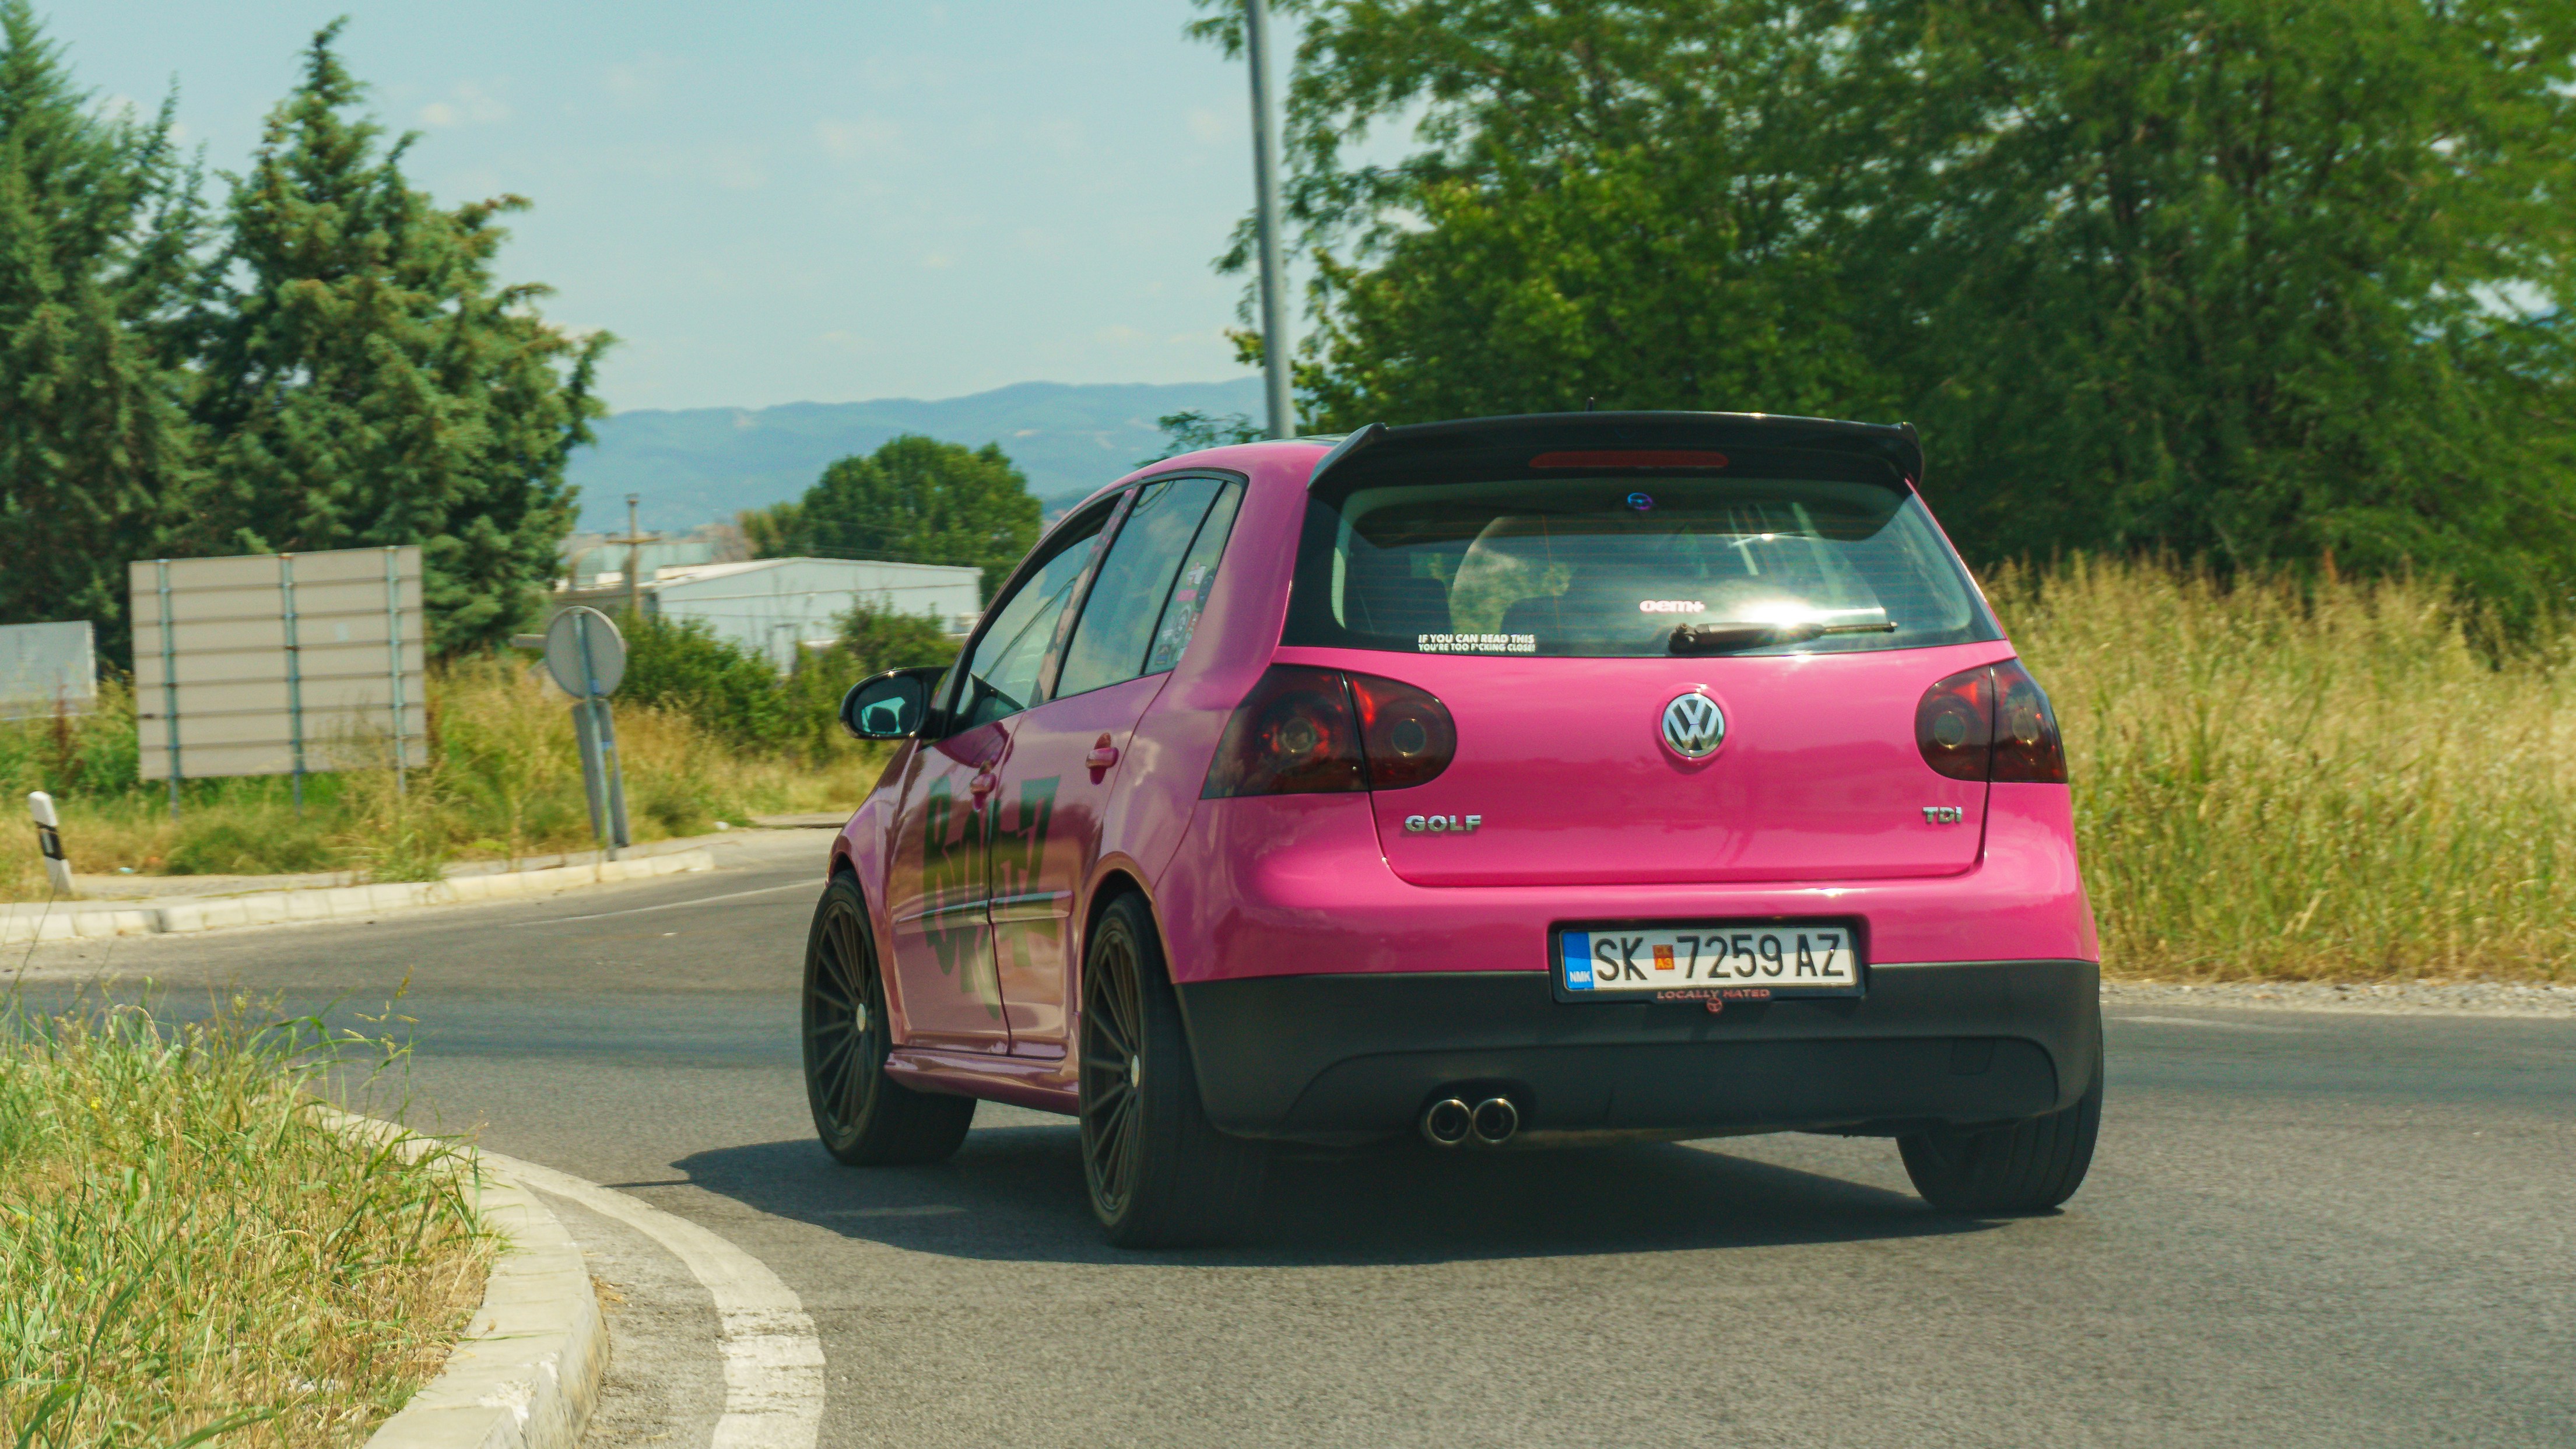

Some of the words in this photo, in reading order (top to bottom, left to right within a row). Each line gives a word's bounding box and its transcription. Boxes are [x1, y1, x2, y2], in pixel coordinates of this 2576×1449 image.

[1639, 600, 1705, 612] oem+
[1418, 634, 1428, 643] IF
[1430, 634, 1454, 643] YOU
[1455, 634, 1479, 643] CAN
[1480, 634, 1509, 643] READ
[1511, 634, 1535, 644] THIS
[1418, 643, 1448, 651] YOU'RE
[1451, 643, 1470, 651] TOO
[1662, 693, 1725, 757] VW
[1922, 806, 1962, 823] TDI
[1405, 815, 1482, 831] GOLF
[1594, 936, 1648, 981] SK
[1677, 934, 1784, 980] 7259
[1795, 933, 1844, 977] AZ
[1569, 970, 1592, 983] NMK
[1656, 990, 1719, 999] LOCALLY
[1722, 988, 1771, 999] HATED
